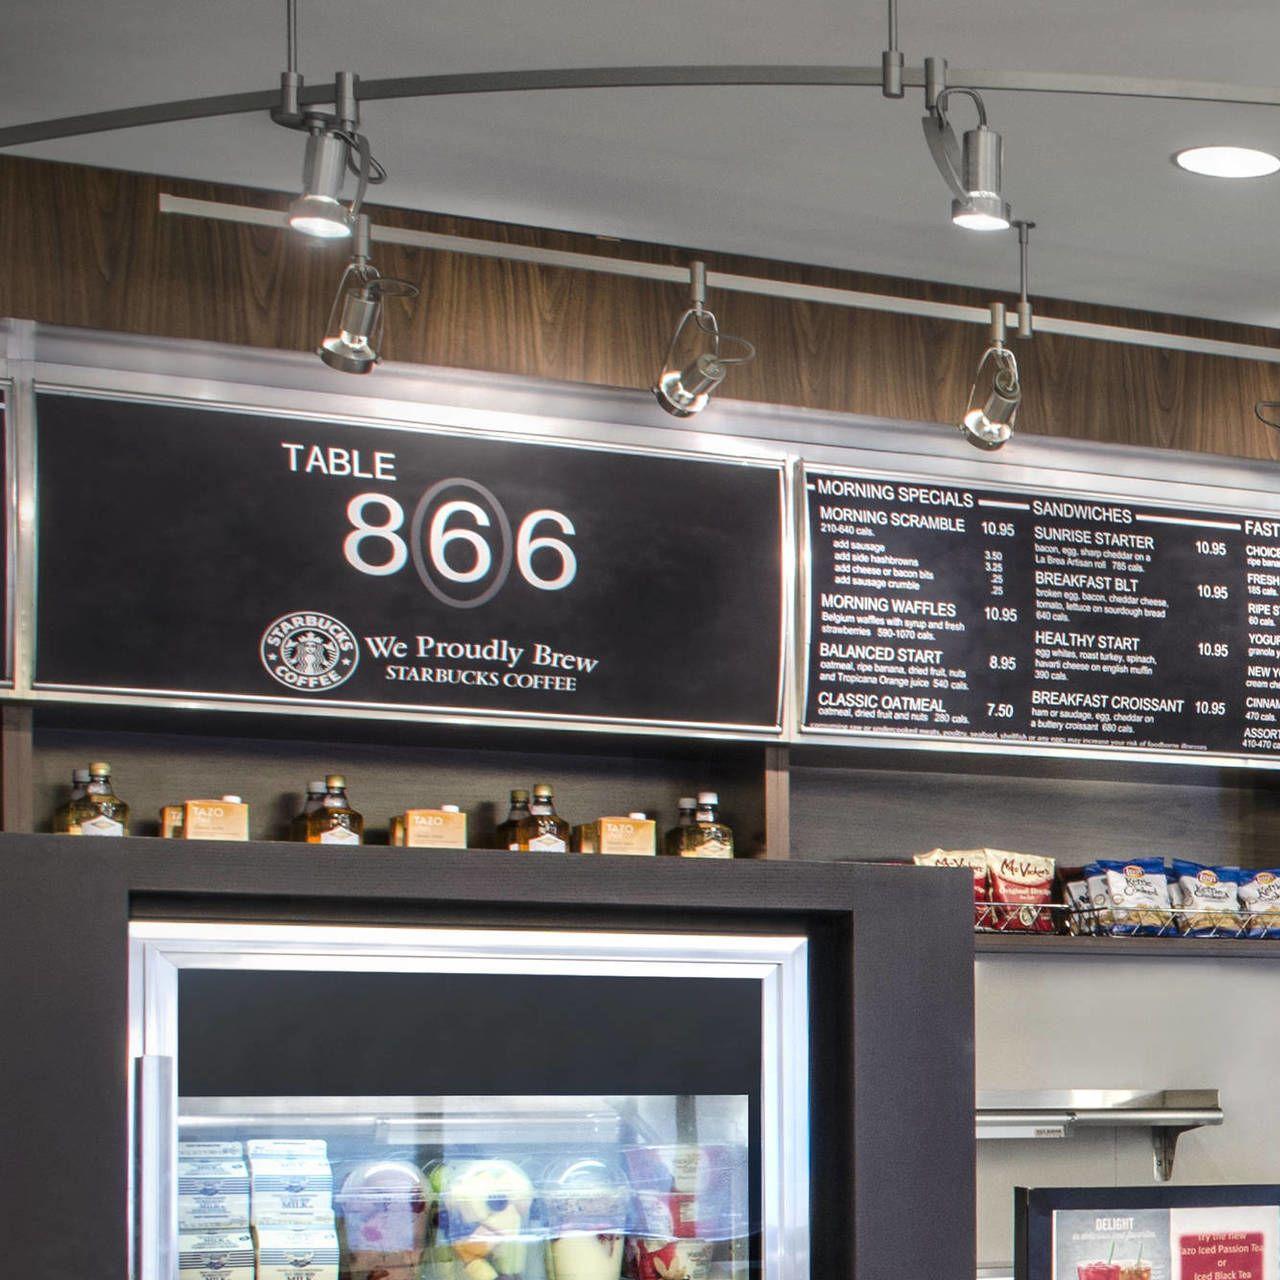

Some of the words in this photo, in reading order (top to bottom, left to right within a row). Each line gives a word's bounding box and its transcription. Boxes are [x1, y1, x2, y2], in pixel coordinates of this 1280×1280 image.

[282, 442, 396, 481] TABLE
[817, 479, 895, 501] MORNING
[898, 489, 974, 508] SPECIALS
[819, 506, 888, 525] MORNING
[891, 514, 965, 533] SCRAMBLE
[981, 521, 1015, 537] 10.95
[1033, 500, 1133, 524] SANDWICHES
[1034, 526, 1092, 544] SUNRISE
[1095, 532, 1155, 550] STARTER
[1195, 541, 1226, 555] 10.95
[1245, 520, 1280, 537] FAST
[342, 492, 578, 591] 866
[1035, 571, 1113, 591] BREAKFAST
[1115, 577, 1138, 592] BLT
[1197, 585, 1228, 599] 10.95
[1247, 573, 1280, 587] FRESH
[821, 594, 888, 612] MORNING
[891, 600, 956, 617] WAFFLES
[985, 607, 1017, 622] 10.95
[1066, 603, 1091, 613] lettuce
[1104, 606, 1143, 618] sourdough
[1144, 608, 1166, 618] bread
[1248, 603, 1270, 615] RIPE
[267, 615, 353, 652] STARBUCKS
[1035, 631, 1095, 647] HEALTHY
[1098, 635, 1140, 651] START
[1198, 643, 1229, 657] 10.95
[364, 636, 407, 658] We
[416, 636, 523, 668] Proudly
[532, 645, 599, 673] Brew
[819, 643, 895, 661] BALANCED
[897, 650, 944, 664] START
[989, 655, 1016, 671] 8.95
[275, 665, 342, 688] COFFEE
[385, 665, 499, 686] STARBUCKS
[502, 674, 577, 691] COFFEE
[819, 673, 835, 682] and
[838, 673, 878, 685] Tropicana
[879, 676, 909, 688] Orange
[910, 679, 929, 689] juice
[1248, 666, 1270, 678] NEW
[818, 691, 878, 708] CLASSIC
[882, 696, 946, 713] OATMEAL
[987, 703, 1013, 718] 7.50
[1032, 691, 1108, 708] BREAKFAST
[1111, 696, 1185, 714] CROISSANT
[1195, 701, 1226, 716] 10.95
[191, 807, 224, 819] TAZO
[413, 815, 443, 827] TAZO
[605, 823, 634, 836] TAZO
[1095, 1217, 1135, 1231] DELIGHT
[1198, 1246, 1216, 1255] Iced
[1218, 1245, 1249, 1253] Passion
[1194, 1273, 1212, 1280] Iced
[1215, 1271, 1236, 1279] Black
[1238, 1270, 1252, 1279] Tea
